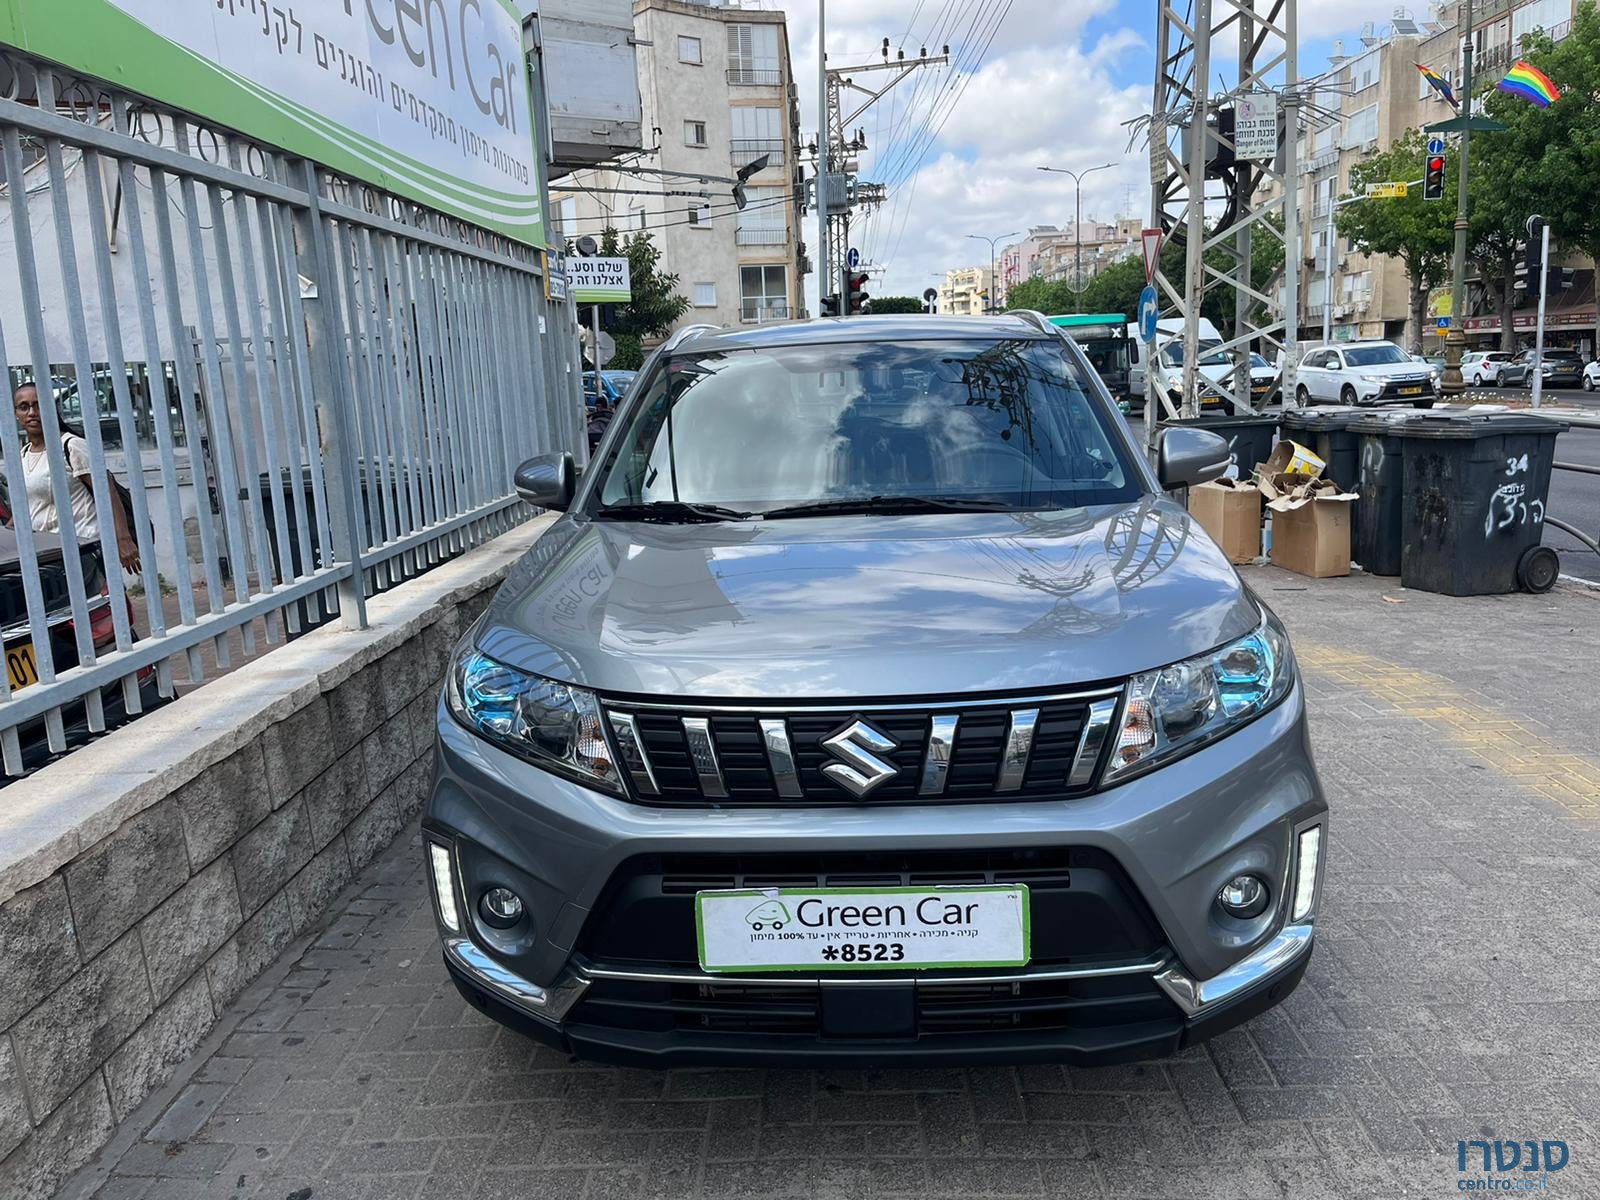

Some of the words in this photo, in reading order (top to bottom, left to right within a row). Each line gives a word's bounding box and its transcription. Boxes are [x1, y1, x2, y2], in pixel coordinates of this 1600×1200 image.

[313, 32, 385, 103] והוגנים
[459, 0, 516, 135] Car
[390, 81, 457, 145] מתקדמים
[459, 124, 490, 164] מימון
[1236, 139, 1253, 148] Danger
[492, 146, 529, 186] פתרונות
[597, 261, 623, 273] שלם
[567, 276, 574, 288] ק
[577, 275, 589, 286] זה
[593, 275, 623, 286] אצלנו
[1505, 454, 1528, 476] 34
[796, 898, 906, 928] Green
[916, 896, 979, 926] Car
[750, 932, 775, 942] מימון
[778, 932, 805, 940] 100%
[826, 932, 840, 941] אין
[876, 930, 911, 939] אחריות
[919, 929, 949, 938] מכירה
[957, 928, 978, 938] קניה
